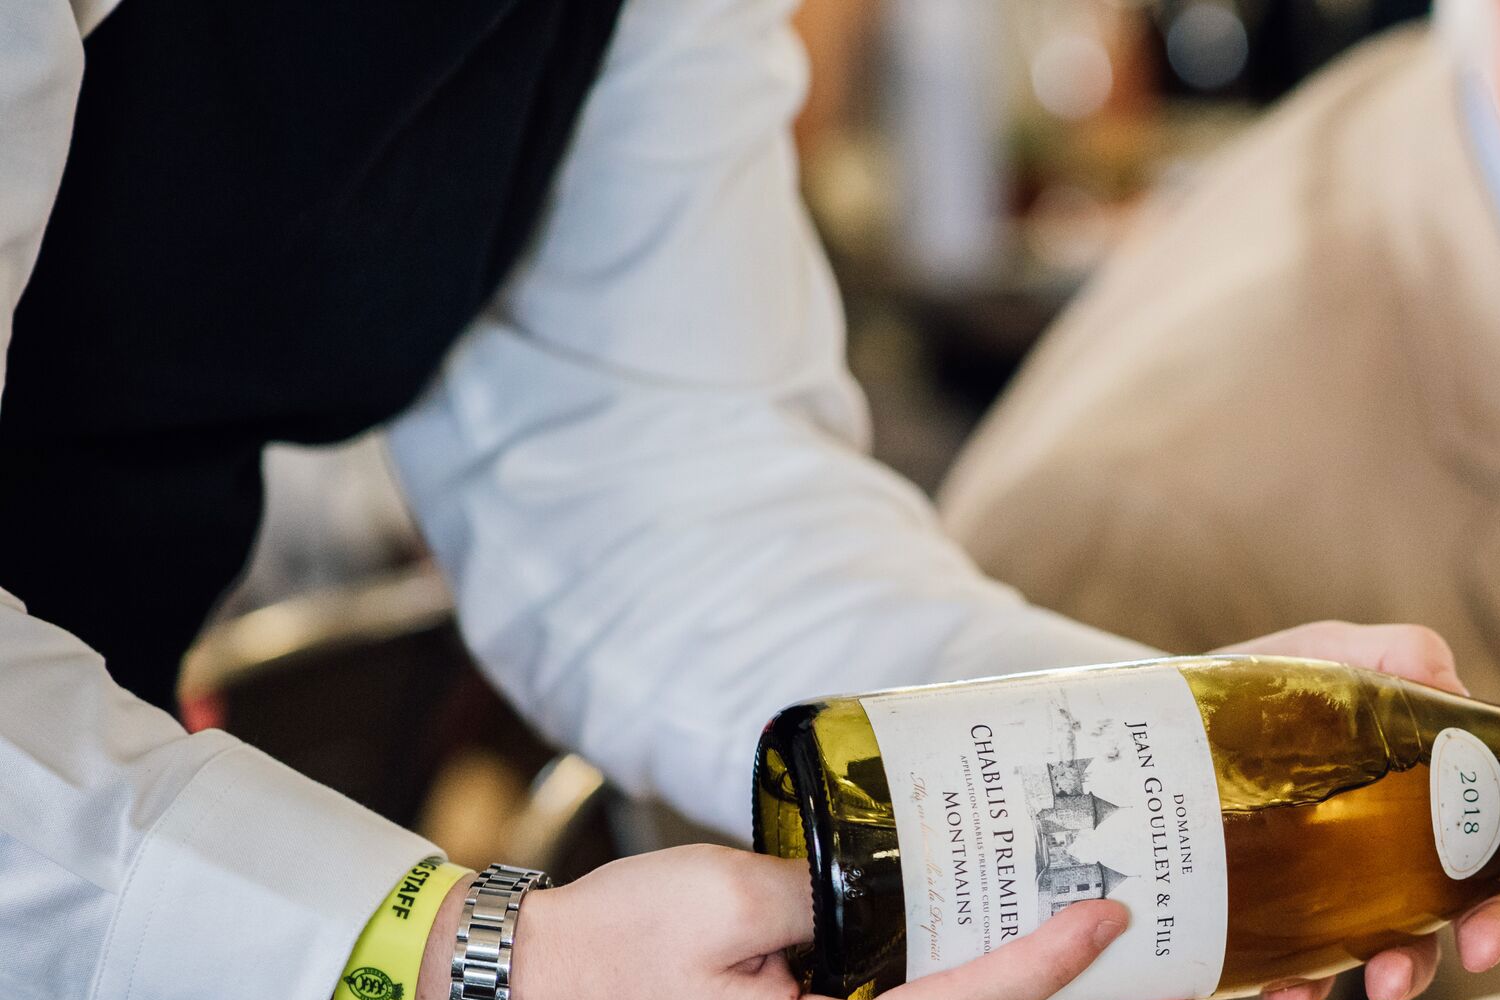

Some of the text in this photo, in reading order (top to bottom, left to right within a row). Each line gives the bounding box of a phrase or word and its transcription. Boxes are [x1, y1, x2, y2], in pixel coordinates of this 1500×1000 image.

[942, 791, 972, 925] MONTMAINS
[960, 754, 992, 955] APPELLATION CHABLIS PREMIER CRU CONTRÔL
[970, 724, 1019, 941] CHABLIS PREMIER
[1124, 721, 1175, 957] JEAN GOULLEY & FILS
[1173, 793, 1193, 875] DOMAINE
[1460, 771, 1481, 834] 2018
[391, 867, 430, 920] STAFF
